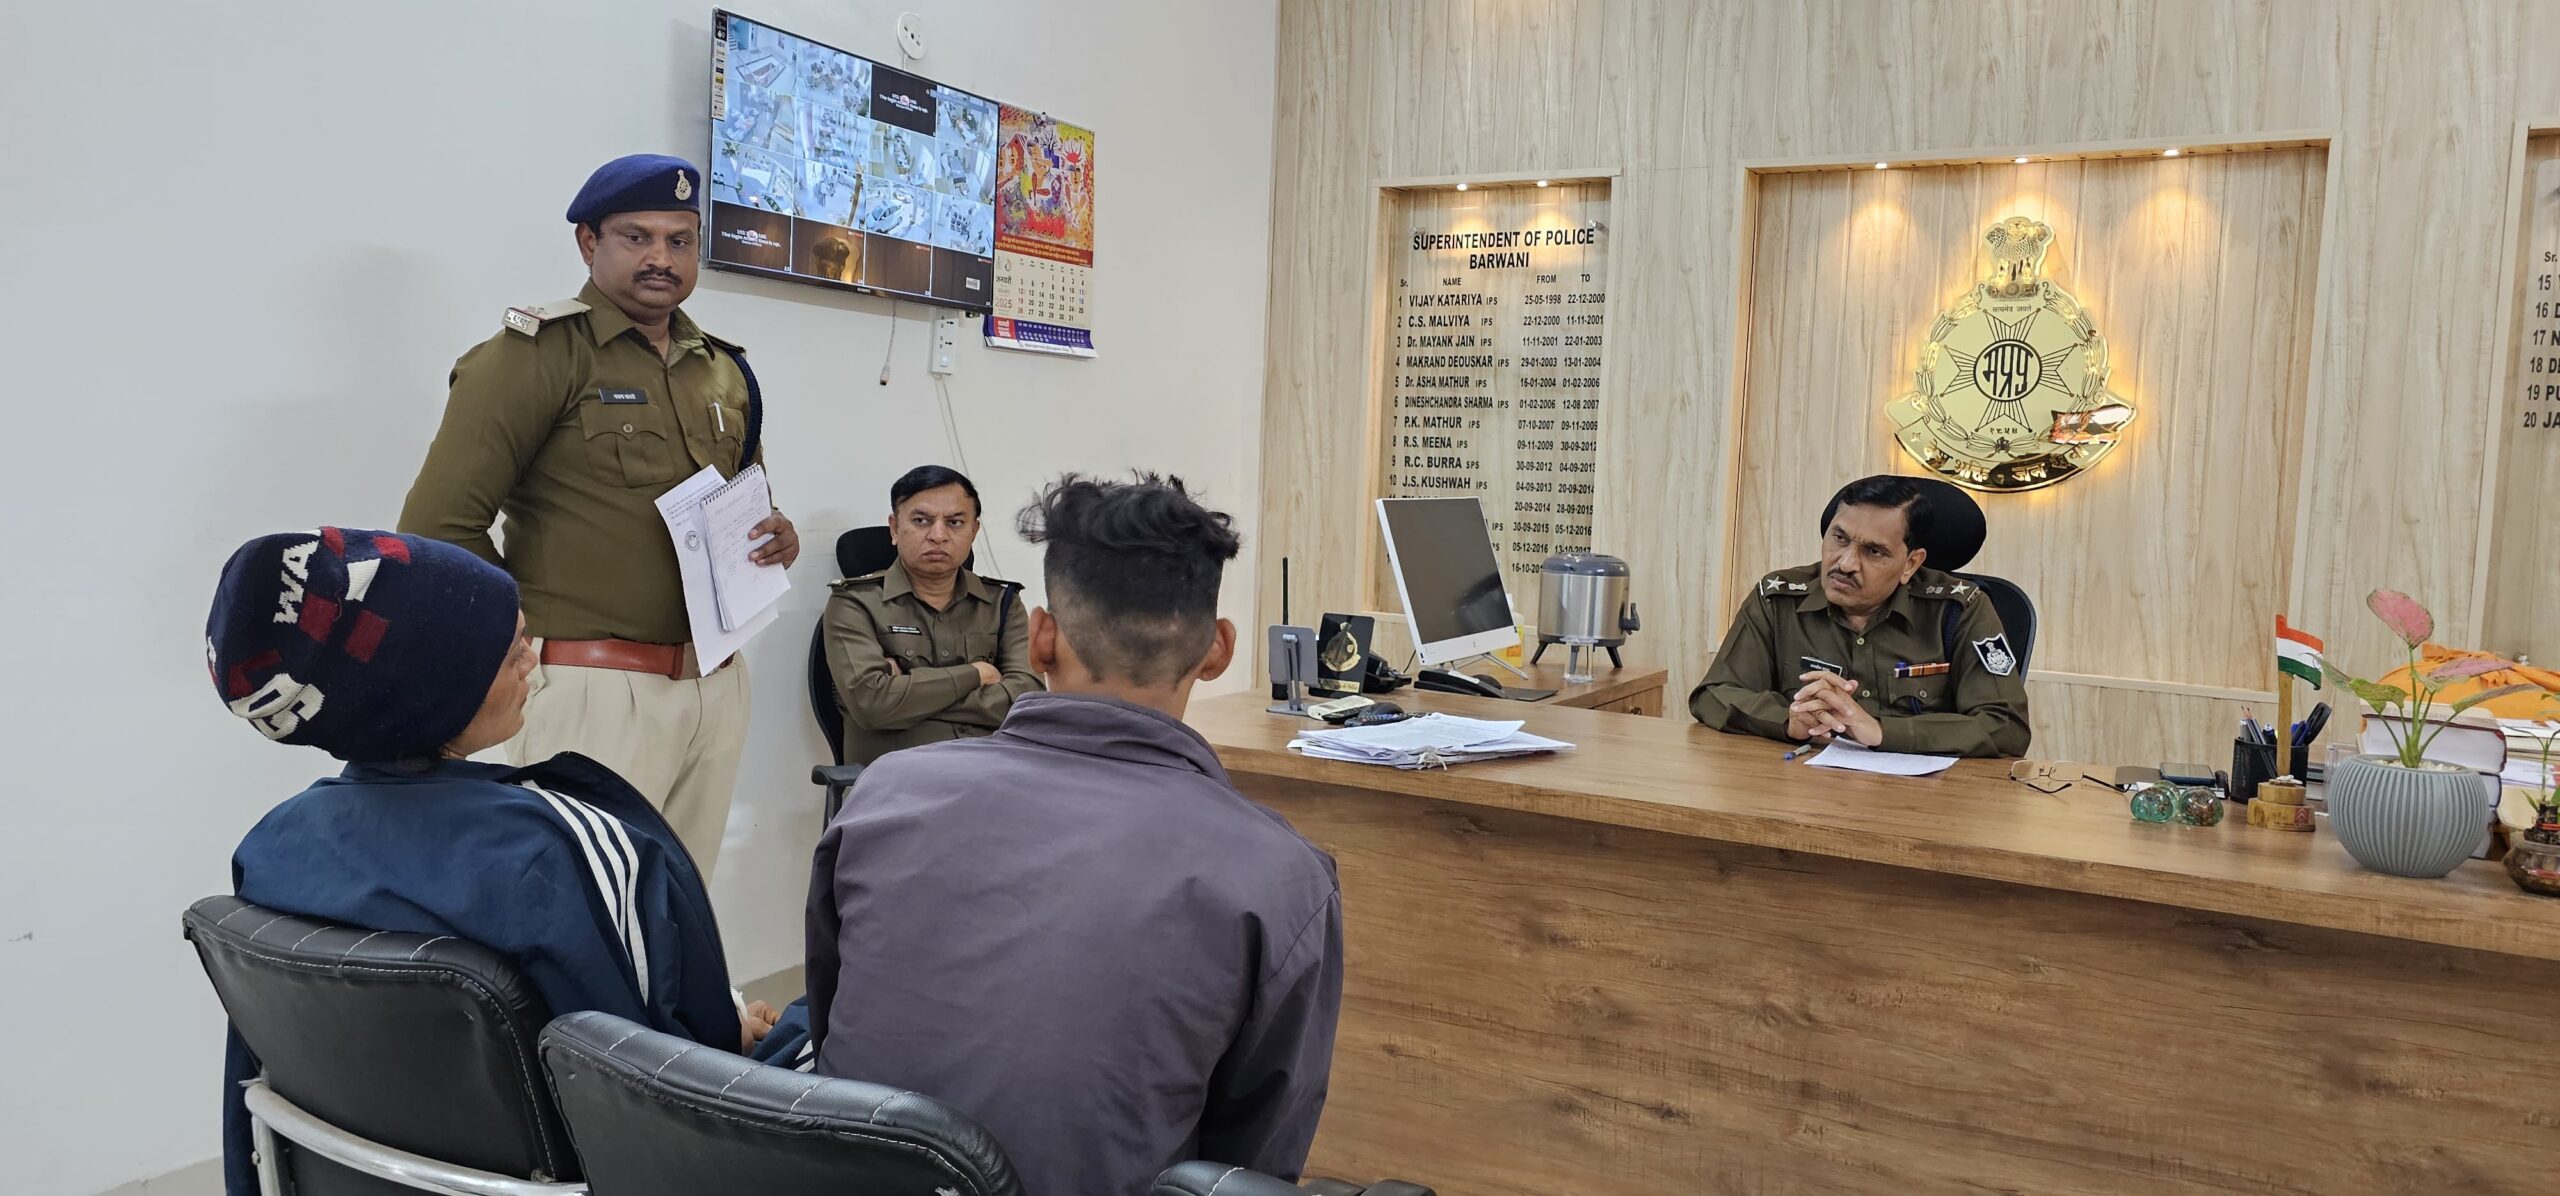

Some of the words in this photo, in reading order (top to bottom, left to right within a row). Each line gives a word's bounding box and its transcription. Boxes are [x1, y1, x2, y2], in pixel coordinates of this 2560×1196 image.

[1413, 232, 1520, 250] SUPERINTENDENT
[1524, 230, 1541, 247] OF
[1546, 228, 1594, 246] POLICE
[1469, 252, 1529, 269] BARWANI
[2544, 252, 2558, 262] Sr.
[1400, 279, 1408, 287] Sr.
[1443, 278, 1461, 286] NAME
[1537, 275, 1556, 284] FROM
[1581, 274, 1590, 282] TO
[2538, 274, 2551, 290] 15
[995, 297, 1013, 309] 2025
[1409, 294, 1435, 307] VIJAY
[1437, 294, 1482, 306] KATARIYA
[1486, 297, 1498, 305] IPS
[1525, 294, 1561, 305] 25-05-1998
[1568, 293, 1605, 303] 22-12-2000
[2535, 302, 2548, 318] 16
[1397, 316, 1402, 328] 2
[1408, 315, 1426, 327] C.S.
[1429, 315, 1470, 327] MALVIYA
[1481, 317, 1493, 326] IPS
[1523, 316, 1560, 325] 22-12-2000
[1567, 315, 1603, 325] 11-11-2001
[1396, 336, 1401, 348] 3
[1407, 336, 1417, 347] Dr.
[1420, 336, 1453, 347] MAYANK
[1456, 335, 1475, 347] JAIN
[1481, 338, 1492, 346] IPS
[1523, 336, 1558, 346] 11-11-2001
[1565, 336, 1602, 346] 22-01-2003
[2533, 330, 2546, 345] 17
[1396, 356, 1400, 368] 4
[1406, 356, 1446, 367] MAKRAND
[1448, 356, 1493, 367] DEOUSKAR
[1498, 359, 1509, 367] IPS
[1521, 357, 1557, 367] 29-01-2003
[1564, 357, 1601, 367] 13-01-2004
[2530, 357, 2543, 373] 18
[1395, 376, 1399, 388] 5
[1405, 376, 1414, 387] Dr.
[1416, 376, 1436, 388] ASHA
[1438, 376, 1469, 388] MATHUR
[1476, 379, 1487, 388] IPS
[1521, 378, 1556, 387] 16-01-2004
[1563, 378, 1600, 388] 01-02-2006
[2527, 384, 2540, 400] 19
[1394, 396, 1398, 408] 6
[1405, 396, 1462, 409] DINESHCHANDRA
[1464, 396, 1493, 409] SHARMA
[1497, 400, 1509, 409] IPS
[1520, 399, 1556, 409] 01-02-2006
[1393, 416, 1397, 428] 7
[1404, 416, 1420, 428] P.K.
[1423, 416, 1462, 429] MATHUR
[1468, 421, 1480, 429] IPS
[1518, 420, 1554, 430] 07-10-2007
[2523, 412, 2536, 428] 20
[1392, 435, 1397, 447] 8
[1403, 436, 1419, 448] R.S.
[1422, 436, 1452, 449] MEENA
[1457, 440, 1468, 449] IPS
[1517, 440, 1553, 450] 09-11-2009
[1560, 441, 1597, 451] 30-09-2012
[1391, 456, 1396, 467] 9
[1404, 456, 1423, 468] R.C.
[1427, 456, 1462, 469] BURRA
[1466, 460, 1480, 470] SPS
[1516, 461, 1552, 471] 30-09-2012
[1389, 474, 1397, 486] 10
[1402, 476, 1420, 488] J.S.
[1421, 477, 1471, 490] KUSHWAH
[1476, 481, 1488, 490] IPS
[1516, 482, 1552, 492] 04-09-2013
[1515, 502, 1550, 512] 20-09-2014
[1492, 522, 1504, 531] IPS
[1513, 522, 1549, 533] 30-09-2015
[1513, 542, 1548, 553] 05-12-2016
